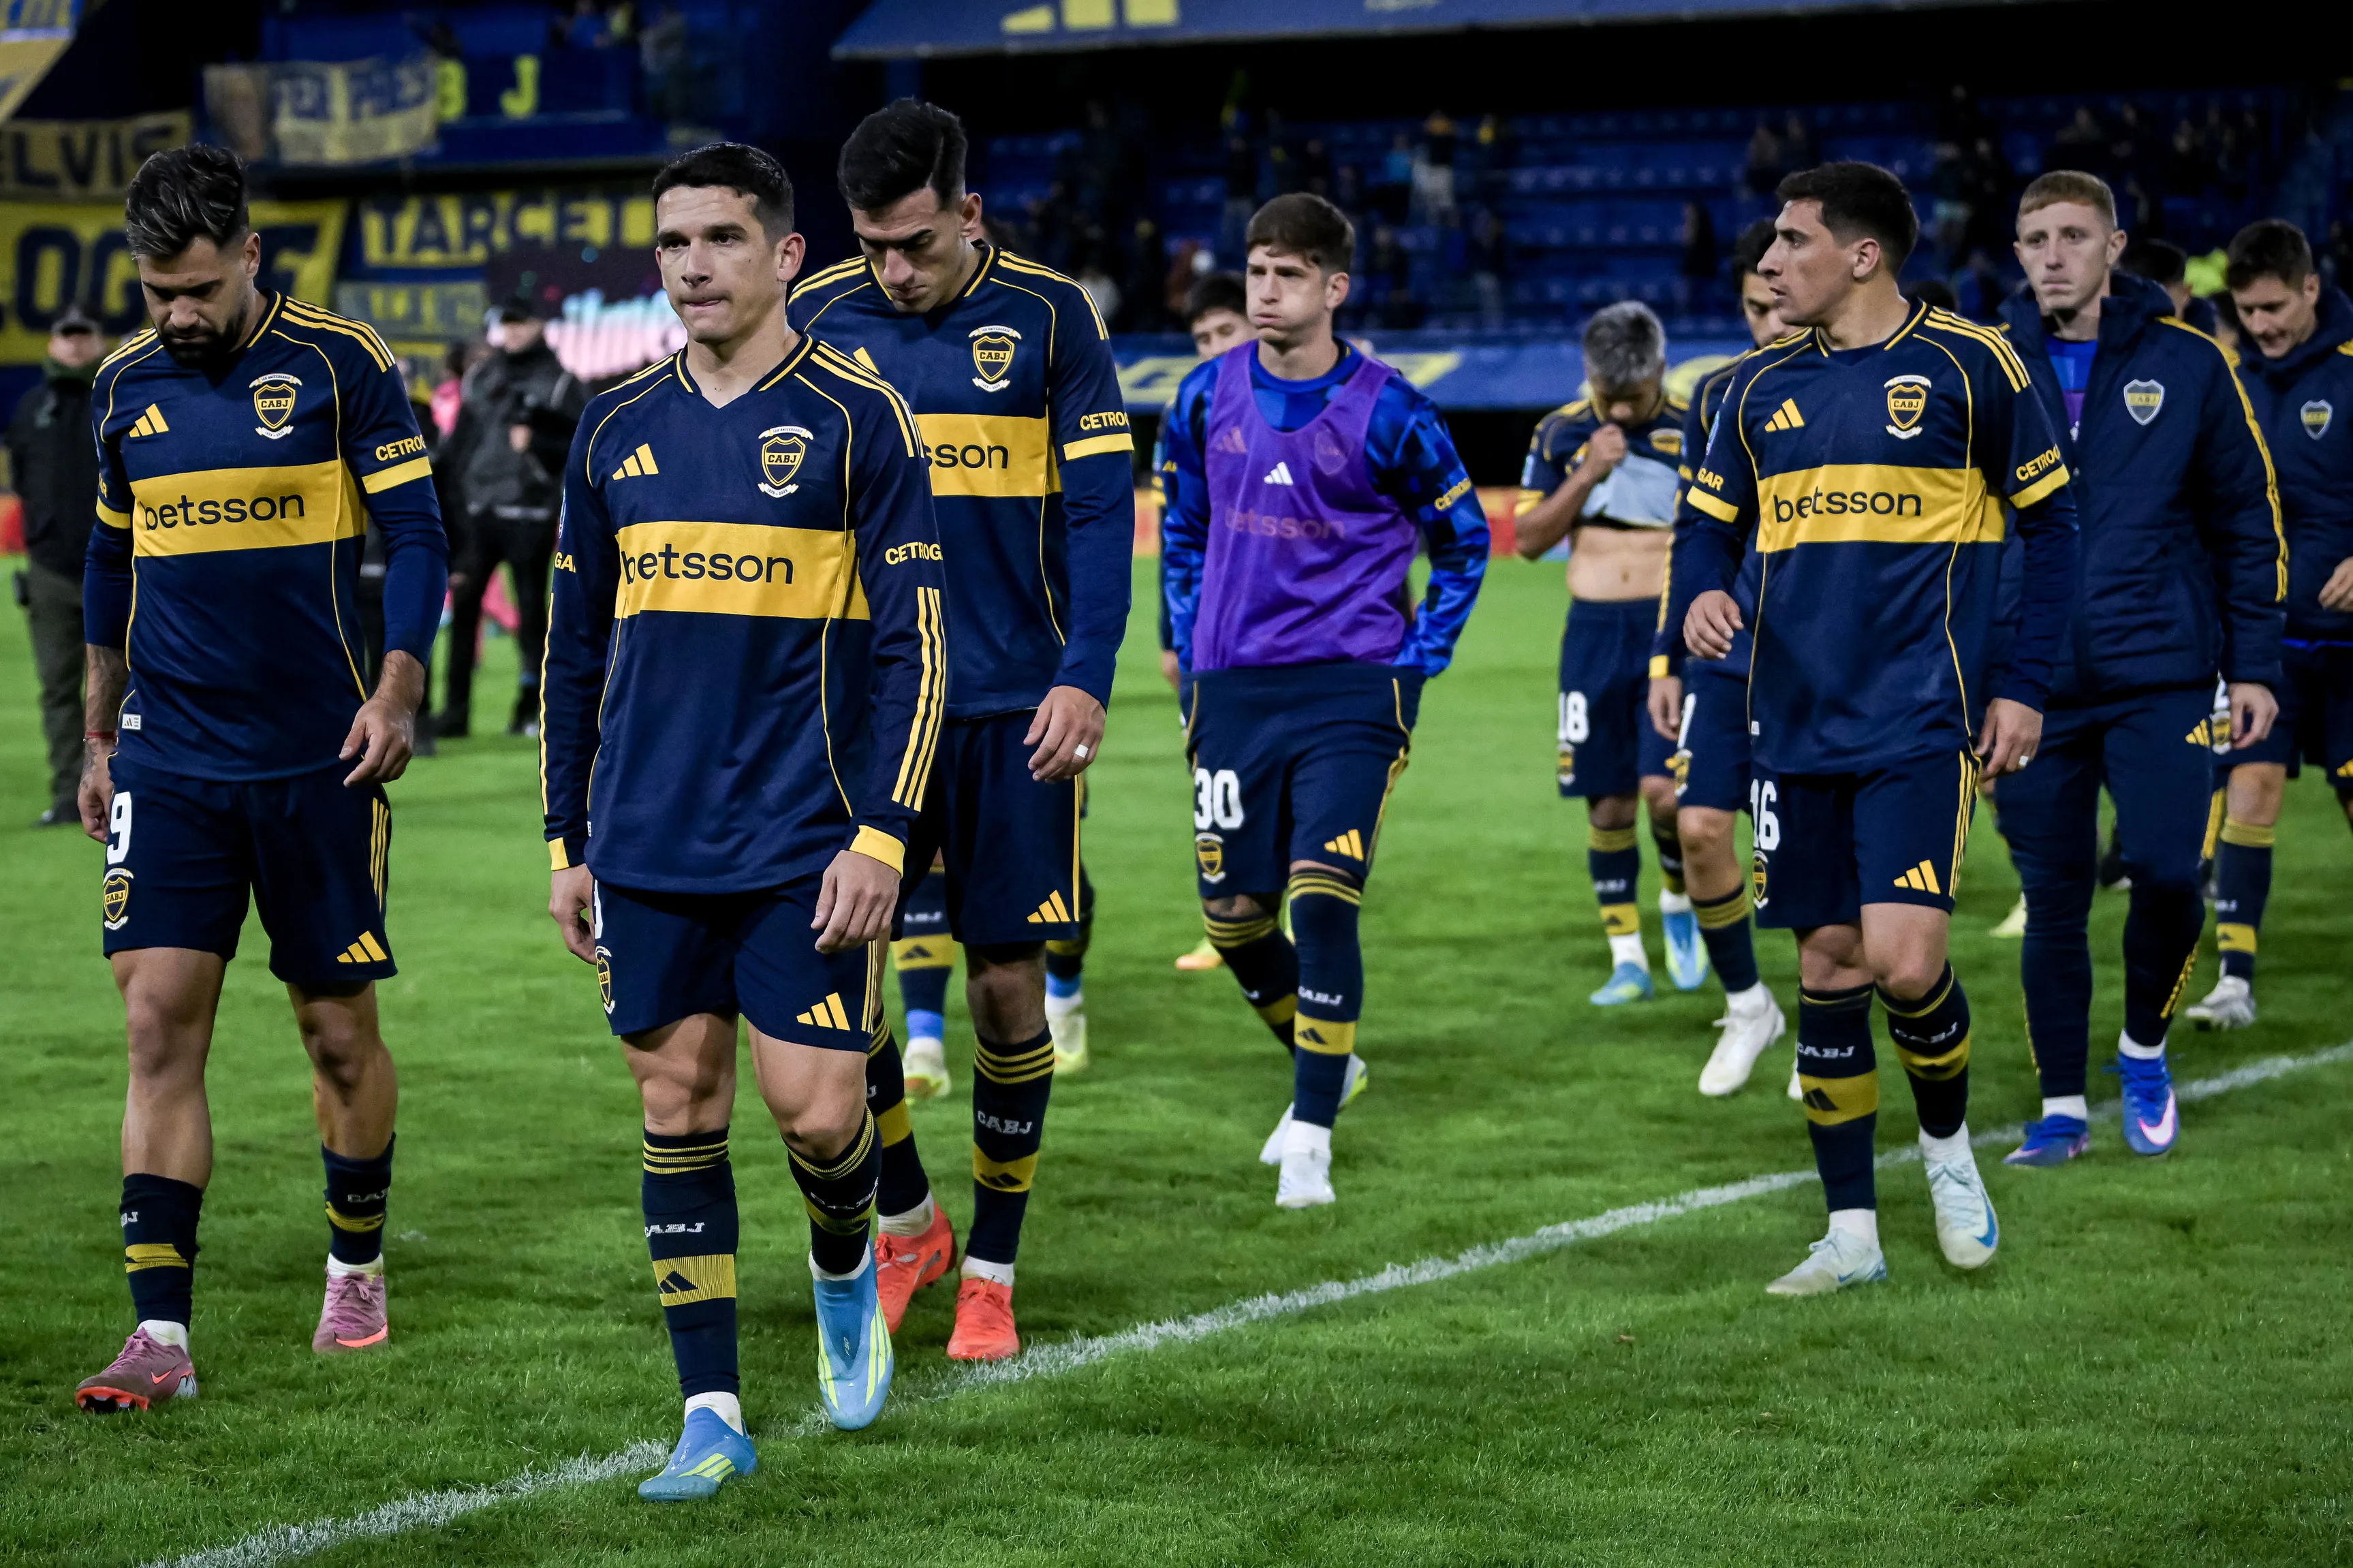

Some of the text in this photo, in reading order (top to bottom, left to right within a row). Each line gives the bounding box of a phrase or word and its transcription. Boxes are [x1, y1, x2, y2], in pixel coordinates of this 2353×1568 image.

[979, 351, 1006, 360] CABJ
[261, 399, 288, 408] CABJ
[768, 454, 797, 463] CABJ
[141, 494, 305, 531] betsson
[1773, 486, 1922, 523] betsson
[555, 551, 576, 573] GA
[621, 543, 794, 584] betsson
[885, 542, 944, 565] CETROG
[1193, 767, 1245, 831] 30
[1749, 778, 1781, 851] 16
[106, 892, 124, 903] CABJ
